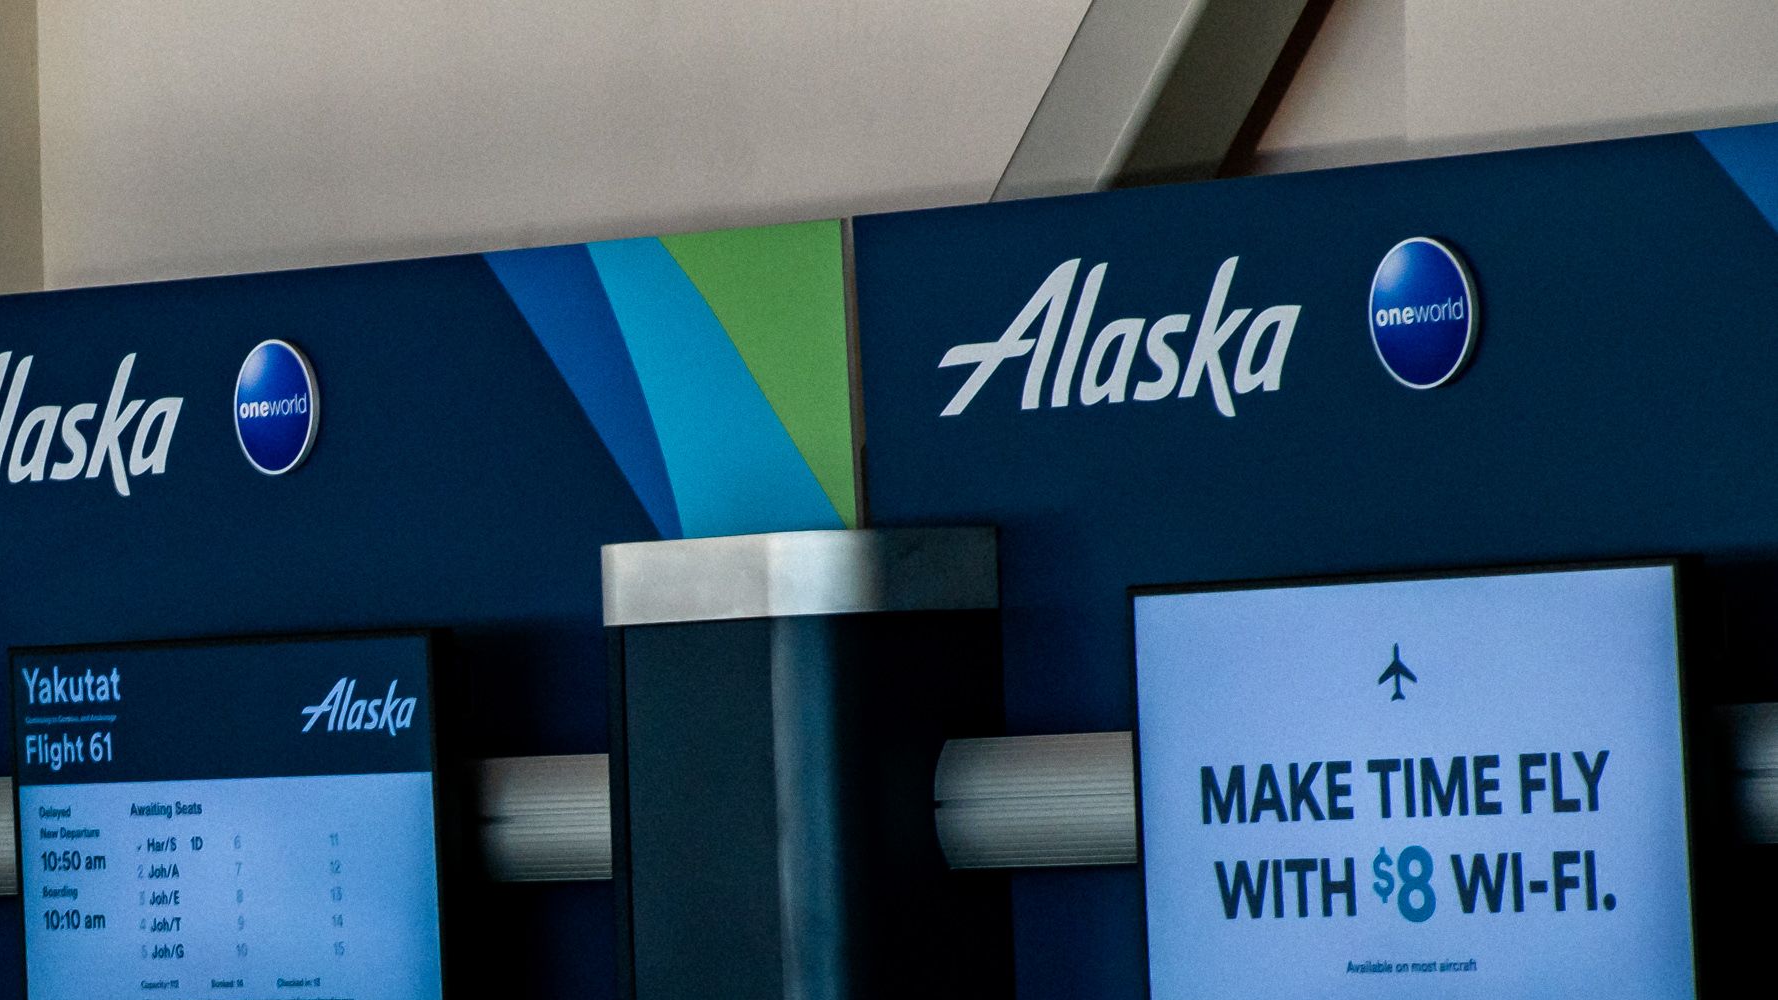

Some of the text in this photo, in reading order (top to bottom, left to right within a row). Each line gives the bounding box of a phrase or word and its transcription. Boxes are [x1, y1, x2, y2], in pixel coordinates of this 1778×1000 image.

[1375, 295, 1465, 327] oneworld
[939, 256, 1302, 416] Alaska
[239, 391, 308, 420] oneworld
[22, 666, 121, 704] Yakutat
[301, 677, 417, 736] Alaska
[25, 731, 113, 771] Flight 61
[1201, 749, 1610, 825] MAKE TIME FLY
[39, 806, 71, 820] Delayed
[130, 801, 203, 819] Awaiting Seats
[40, 827, 100, 840] New Departure
[147, 836, 203, 852] Har/S 1D
[41, 851, 106, 872] 10:50 am
[148, 863, 180, 879] Joh/A
[42, 886, 78, 900] Boarding
[1215, 844, 1618, 923] WITH $8 WI-FI.
[149, 890, 180, 905] Joh/E
[44, 909, 106, 930] 10:10 am
[150, 917, 182, 932] Joh/T
[151, 944, 185, 959] Joh/G
[1346, 958, 1478, 975] Available on most aircraft
